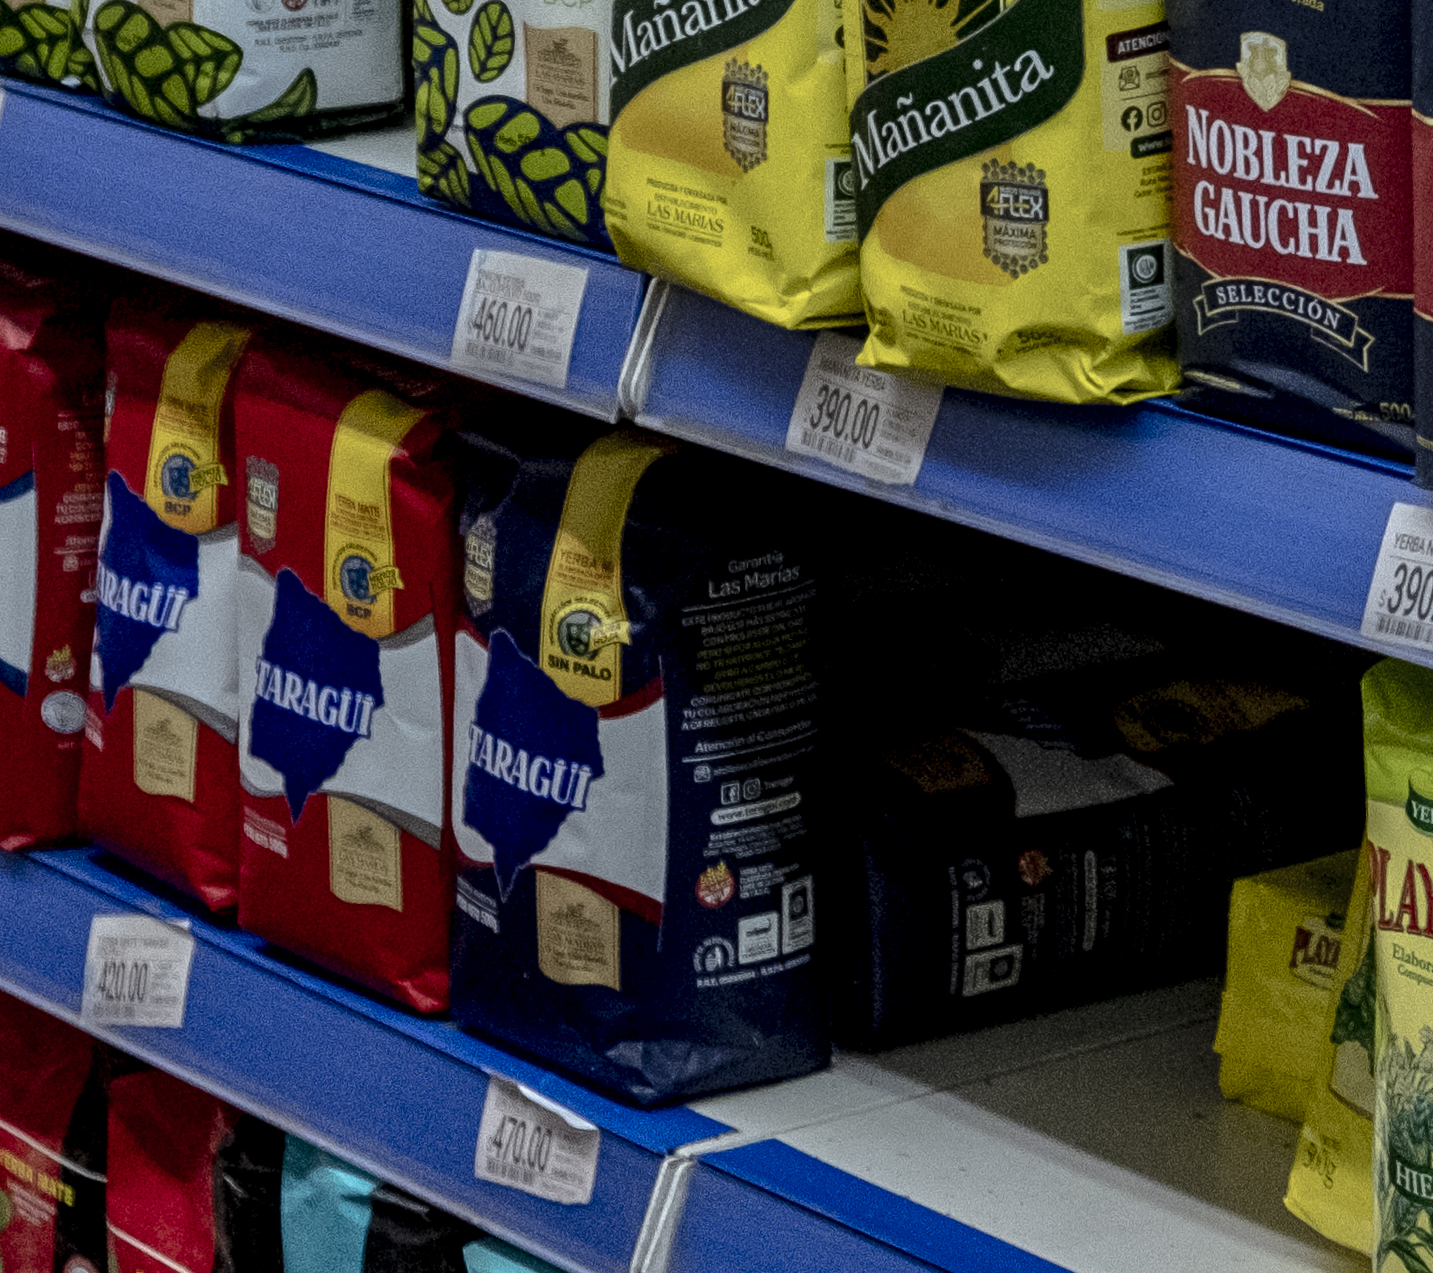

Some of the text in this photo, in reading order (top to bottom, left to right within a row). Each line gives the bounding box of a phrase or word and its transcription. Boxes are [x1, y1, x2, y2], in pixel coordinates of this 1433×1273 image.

[854, 46, 1054, 189] Mañanita
[1185, 104, 1378, 201] NOBLEZA
[1193, 184, 1367, 265] GAUCHA
[1215, 285, 1341, 331] SELECCIÓN
[547, 655, 612, 683] SIN PALO
